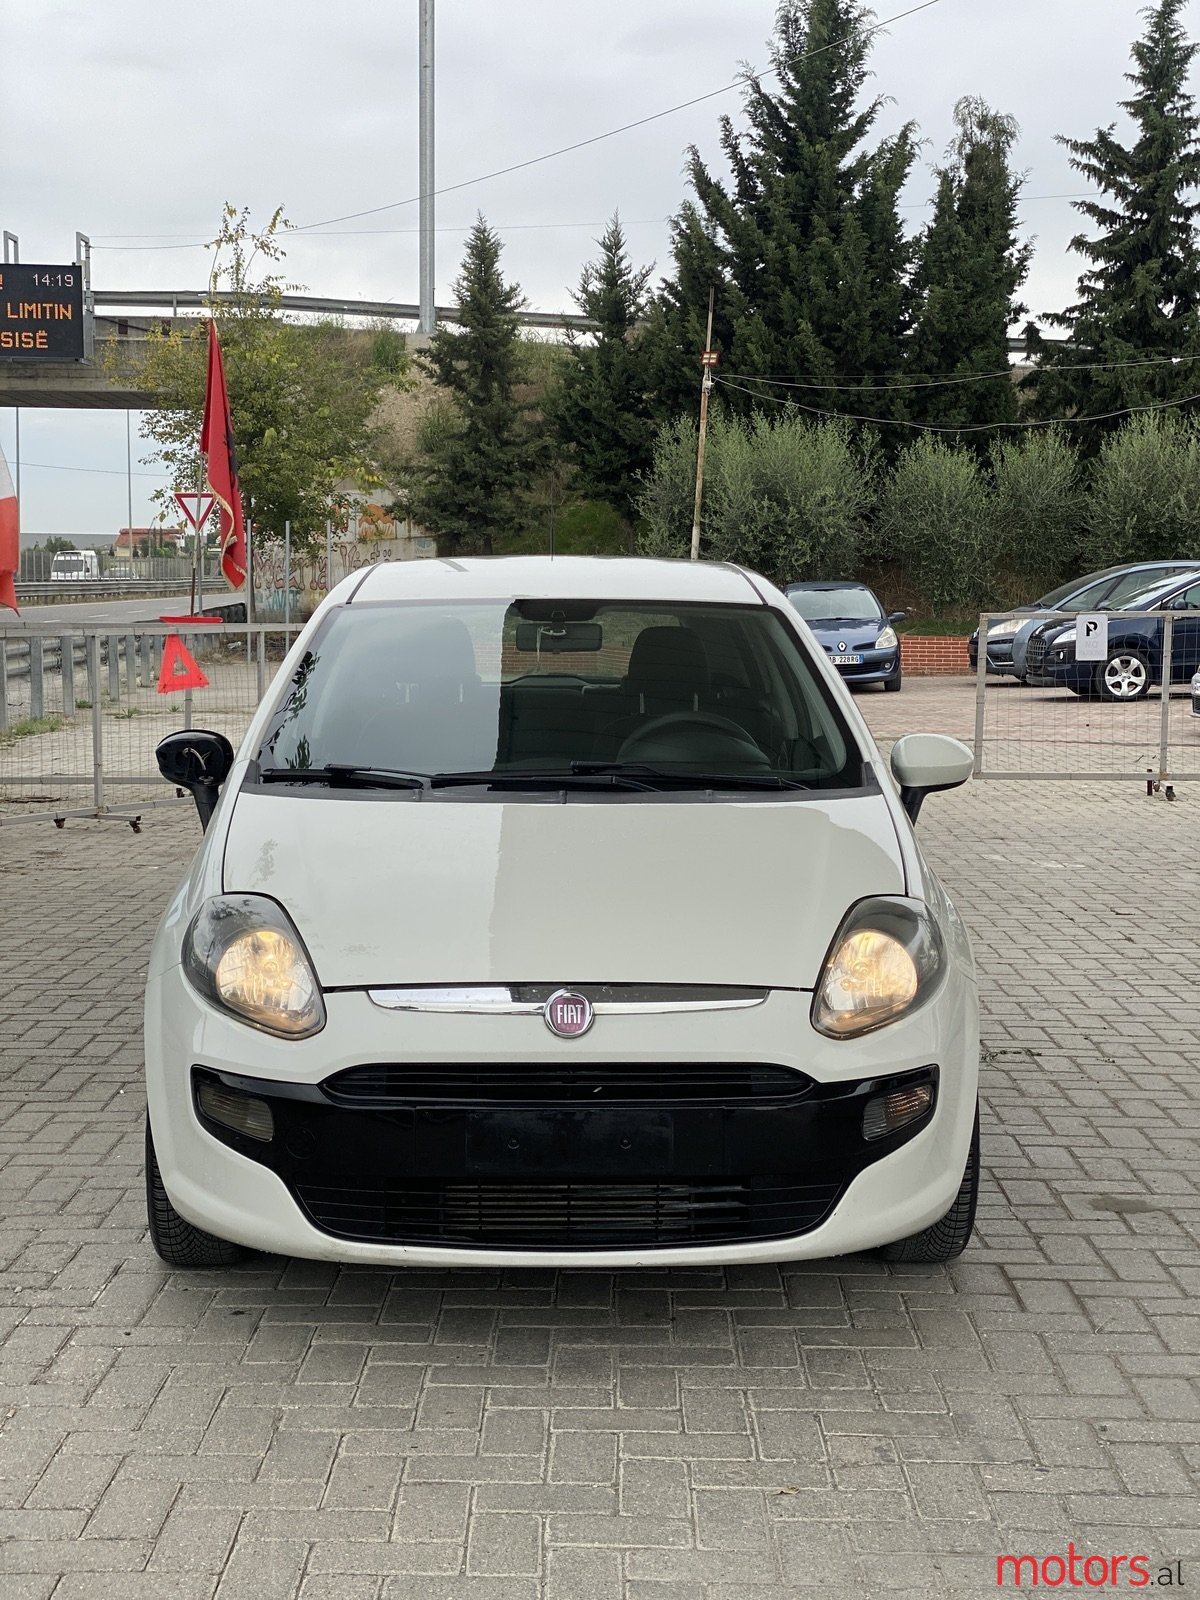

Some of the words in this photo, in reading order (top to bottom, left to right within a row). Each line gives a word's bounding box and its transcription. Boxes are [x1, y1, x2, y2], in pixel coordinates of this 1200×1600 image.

[33, 273, 74, 287] 14:19
[7, 302, 72, 320] LIMITIN
[0, 329, 48, 349] SISË
[1085, 621, 1098, 637] P
[557, 1004, 583, 1024] FIAT
